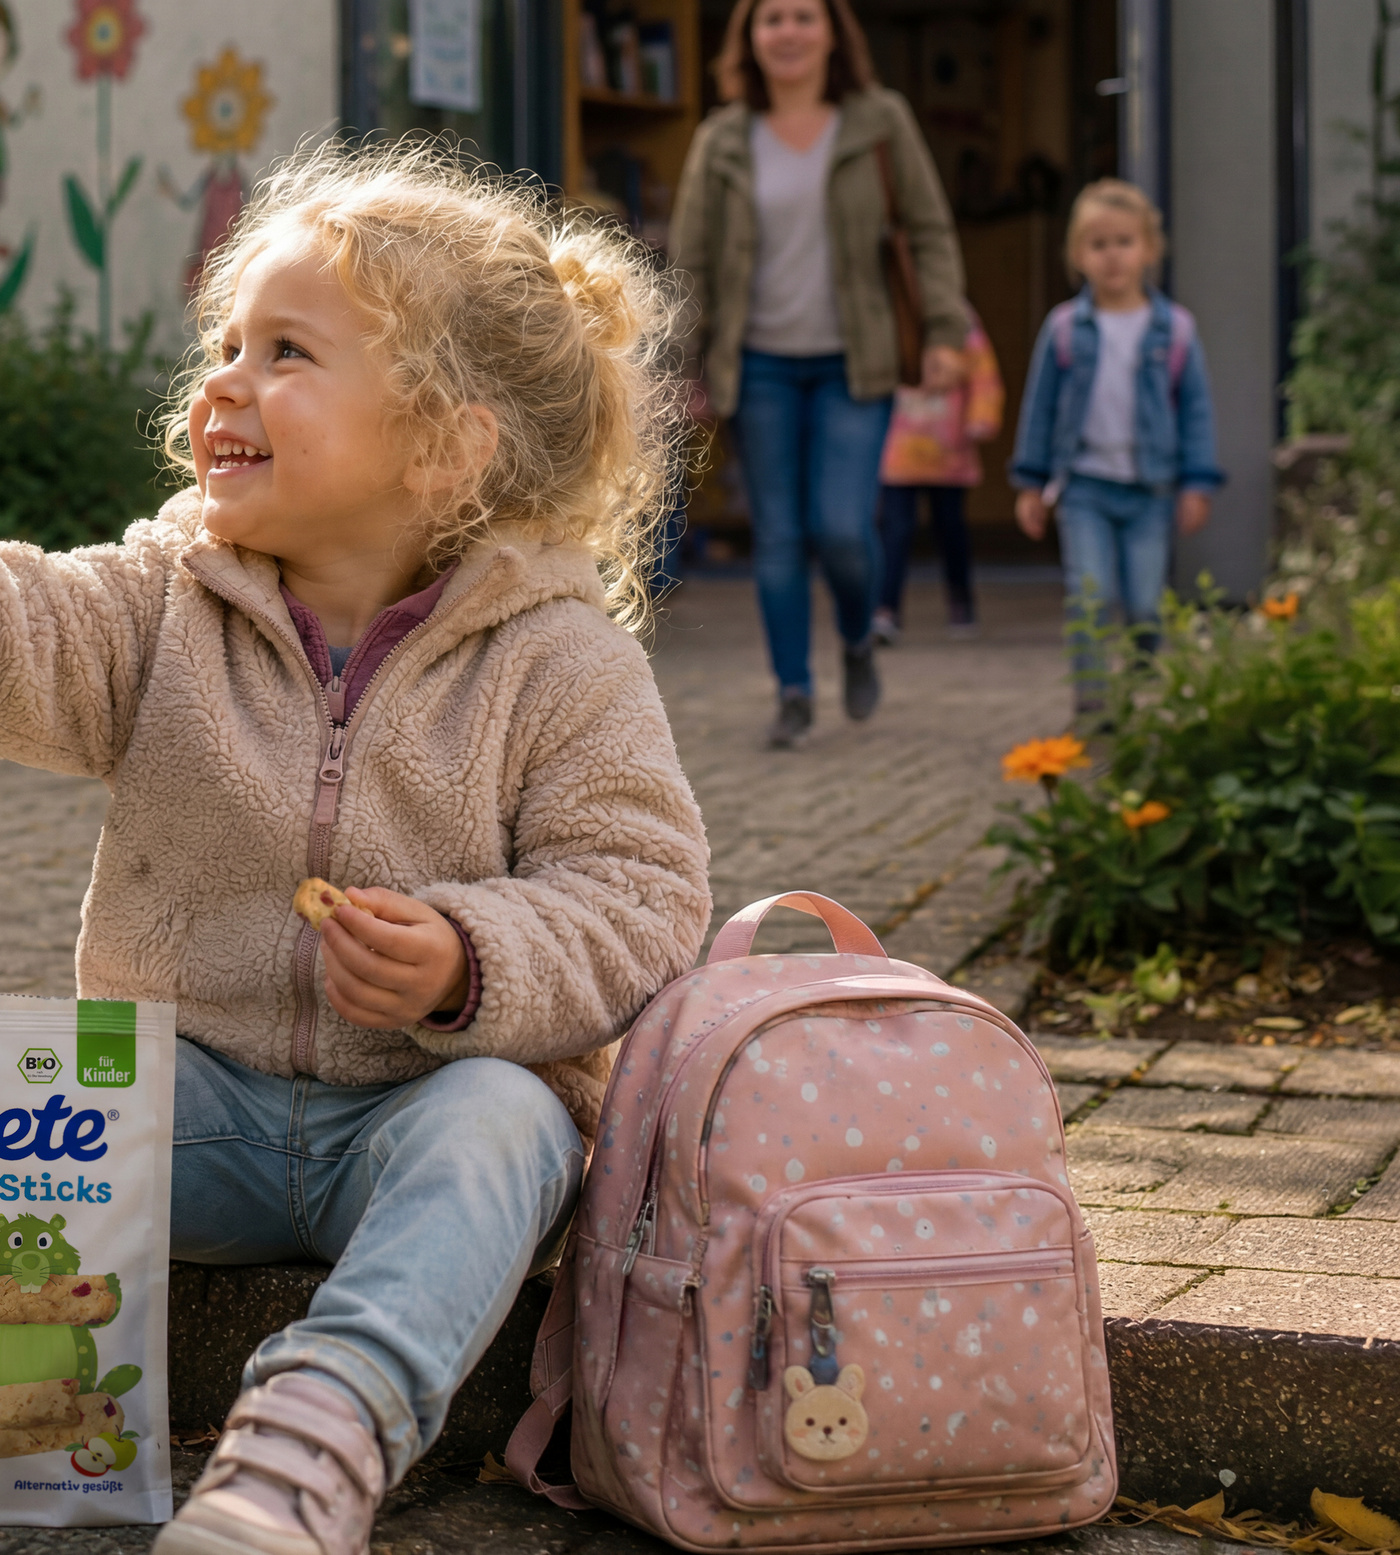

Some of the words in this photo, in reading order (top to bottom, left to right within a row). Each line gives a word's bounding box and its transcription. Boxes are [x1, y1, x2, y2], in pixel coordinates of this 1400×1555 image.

[98, 1055, 116, 1067] für
[83, 1067, 131, 1083] Kinder
[14, 1480, 80, 1491] Alternativ
[82, 1480, 123, 1494] gesüßt
